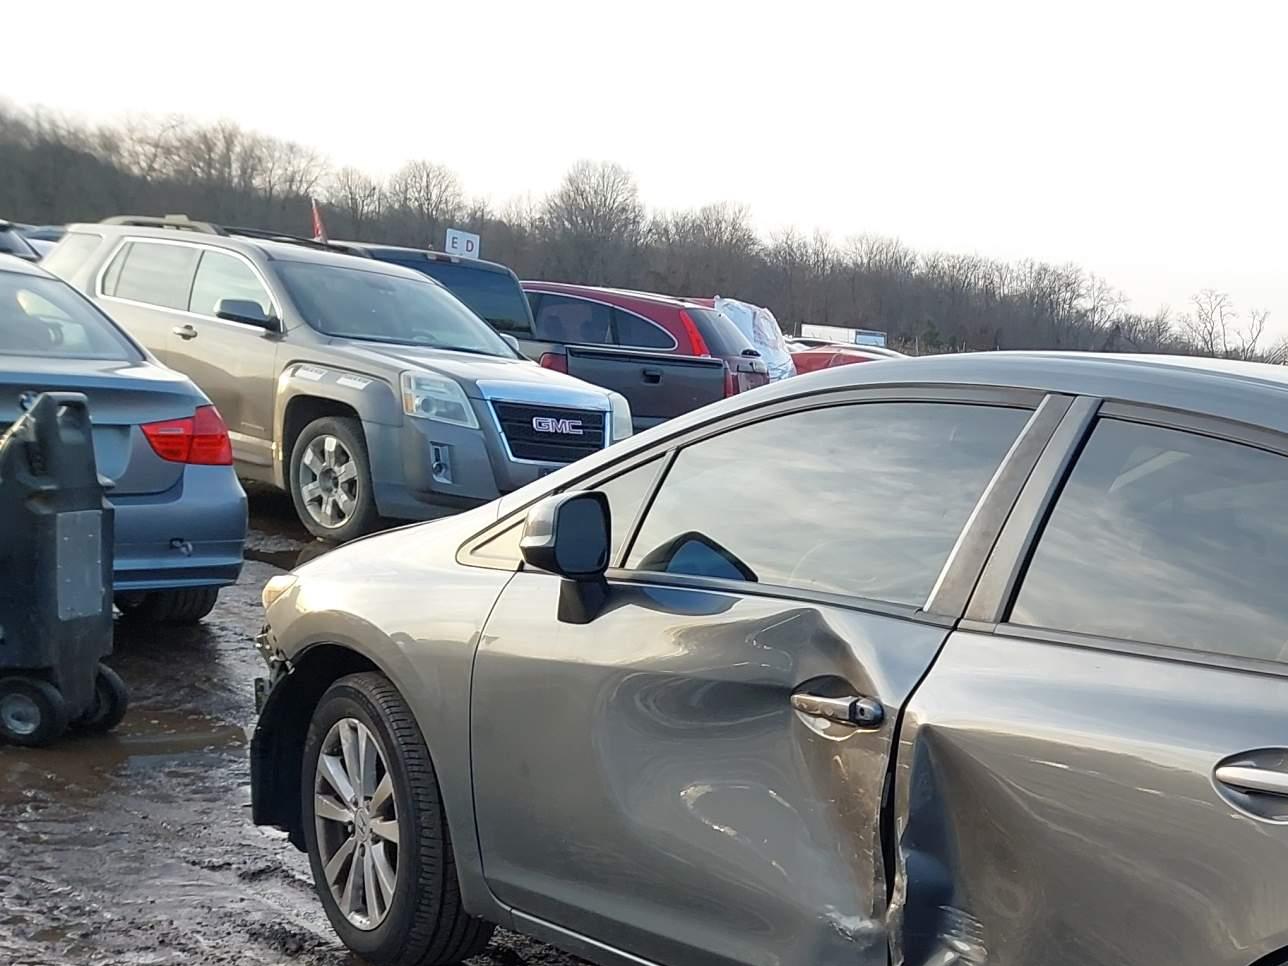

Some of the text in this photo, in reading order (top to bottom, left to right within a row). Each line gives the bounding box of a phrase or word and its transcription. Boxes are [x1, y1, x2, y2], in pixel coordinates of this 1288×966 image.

[451, 236, 475, 253] E D
[532, 416, 584, 435] GMC
